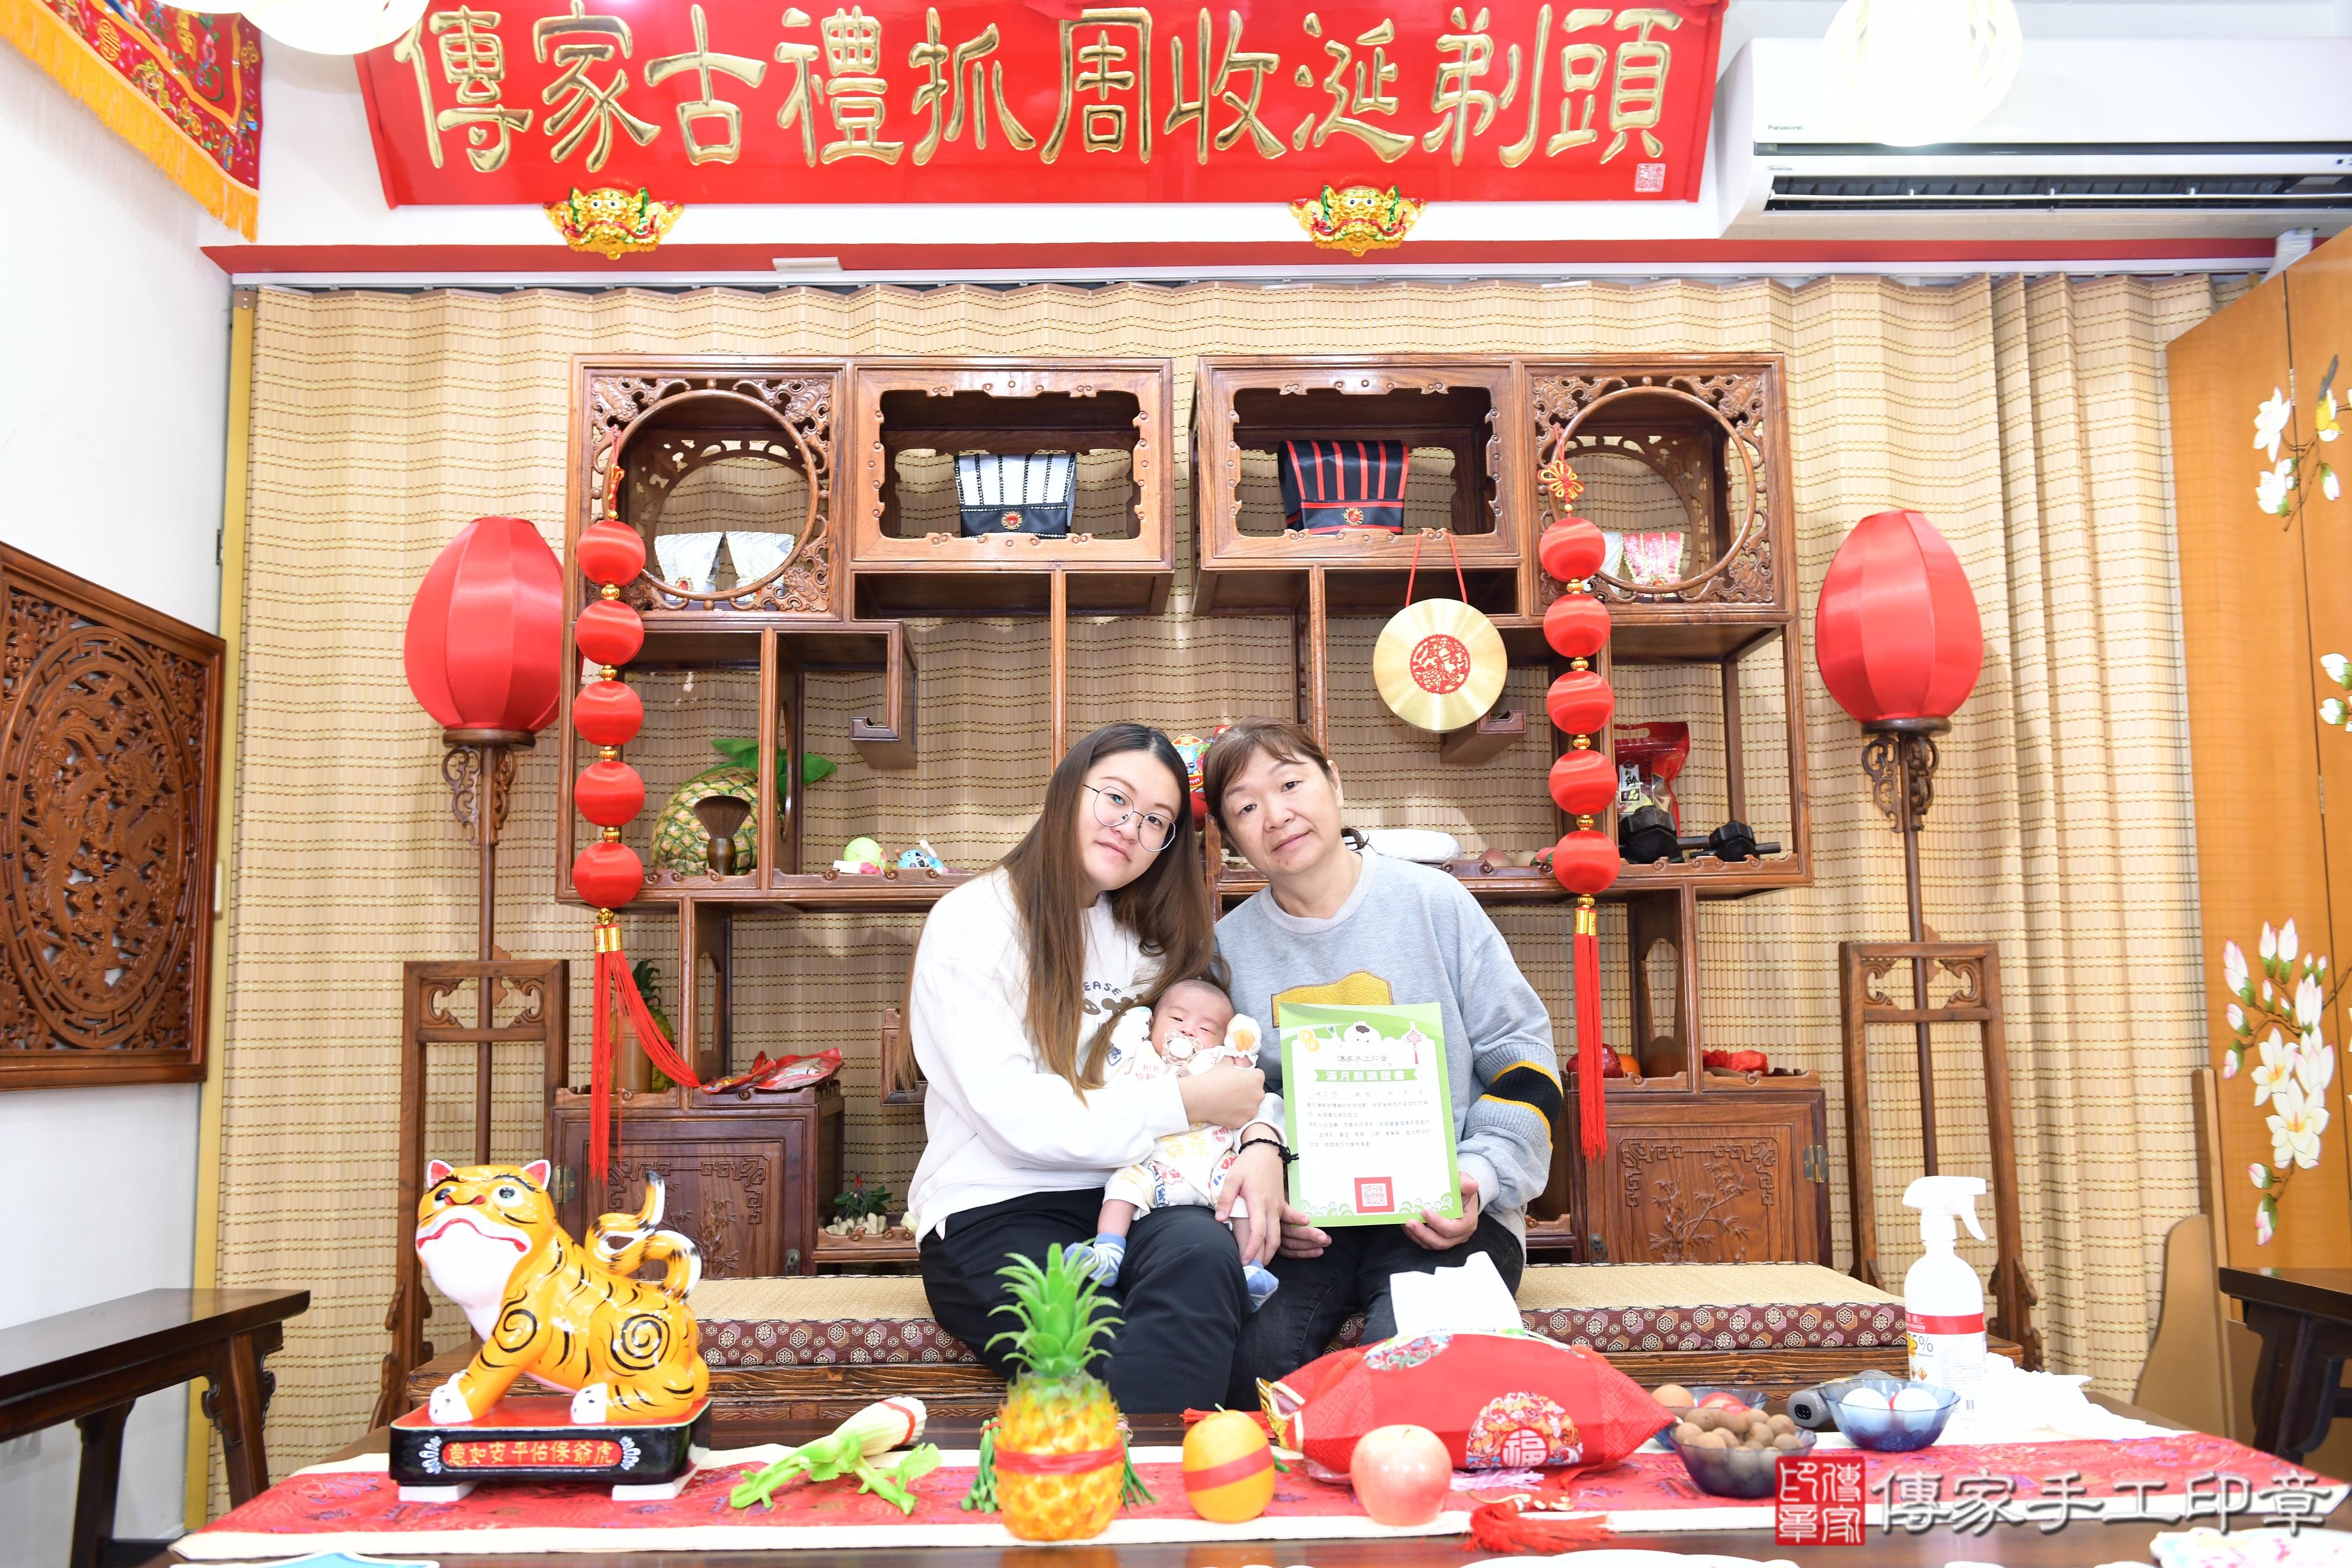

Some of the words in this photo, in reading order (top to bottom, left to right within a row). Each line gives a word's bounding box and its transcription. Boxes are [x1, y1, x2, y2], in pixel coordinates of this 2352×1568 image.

[393, 0, 1684, 173] 傳家古禮抓周收涎剃頭
[1326, 1070, 1405, 1081] 滿月剃頭證書
